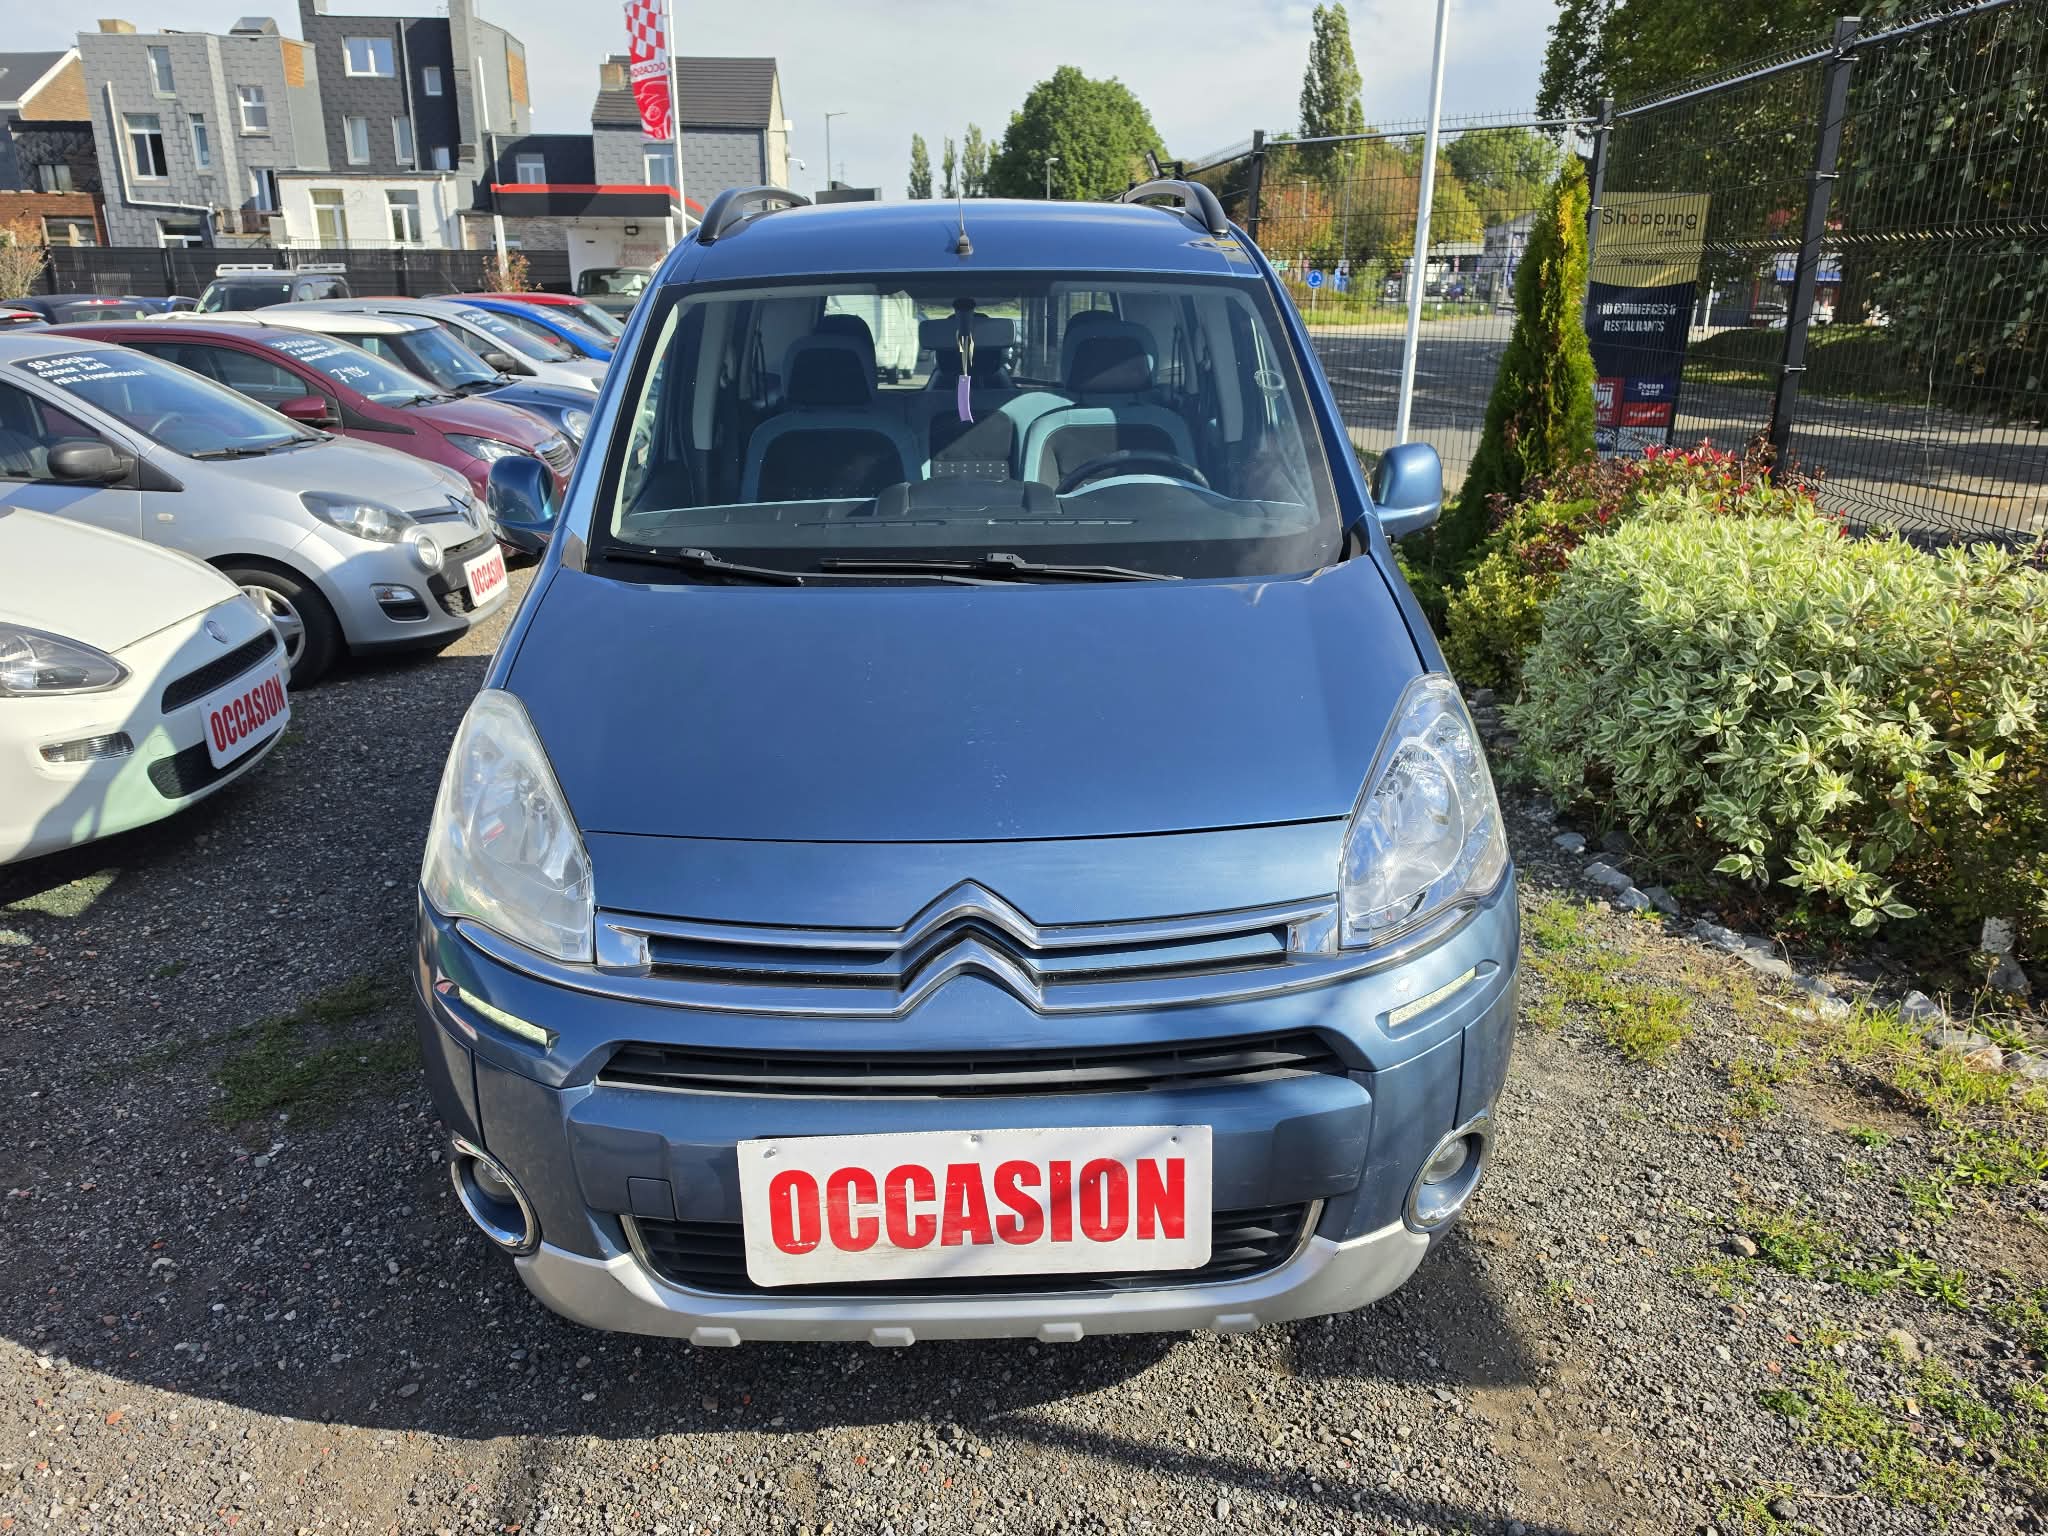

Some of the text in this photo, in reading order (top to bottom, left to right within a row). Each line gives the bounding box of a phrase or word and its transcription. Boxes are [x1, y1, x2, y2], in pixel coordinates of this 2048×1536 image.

[1602, 208, 1698, 230] Shopping
[1603, 320, 1665, 332] RESTAURANTS
[210, 673, 286, 753] OCCASION
[768, 1157, 1186, 1256] OCCASION
